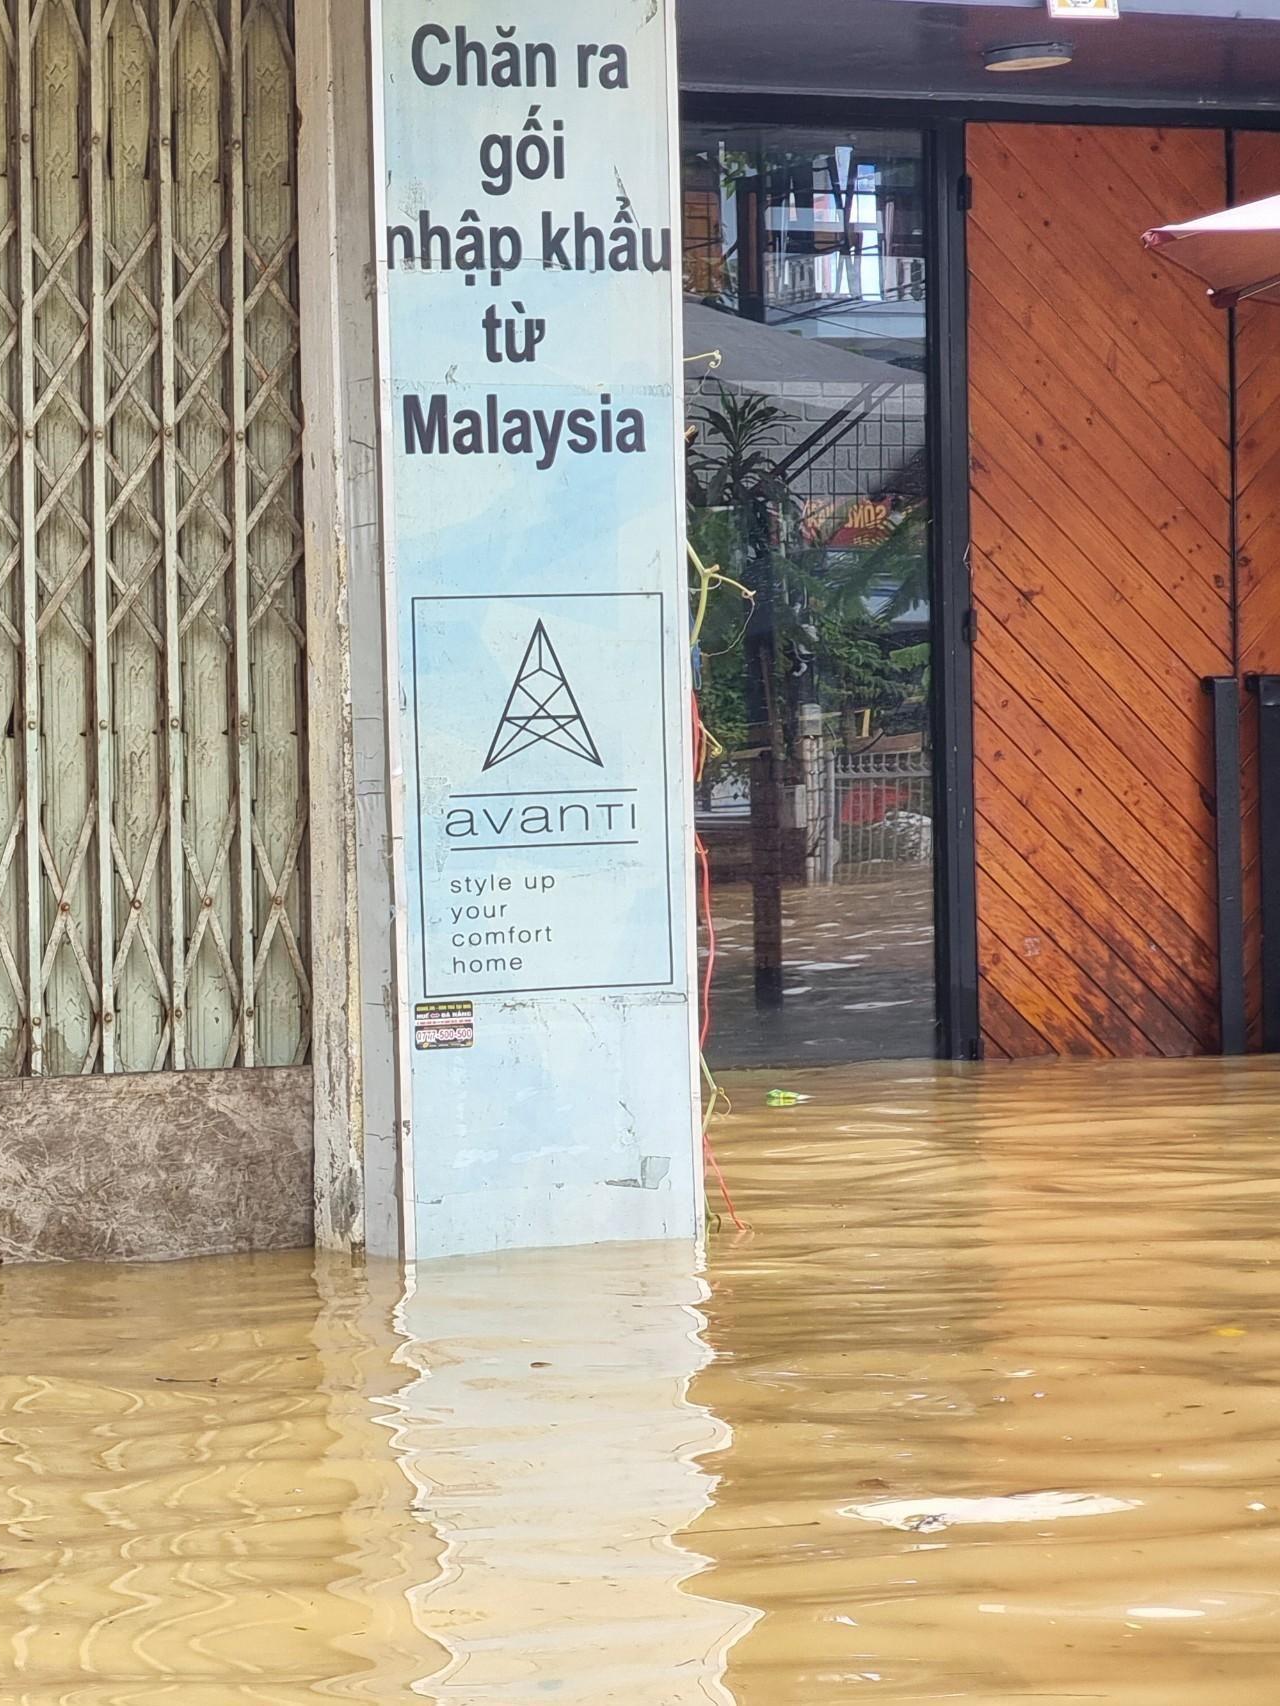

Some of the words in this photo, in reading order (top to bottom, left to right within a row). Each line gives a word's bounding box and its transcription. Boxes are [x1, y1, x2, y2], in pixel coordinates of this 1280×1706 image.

[411, 23, 557, 88] Chăn
[577, 41, 629, 90] ra
[480, 104, 566, 196] gối
[387, 209, 522, 287] nhập
[541, 196, 672, 272] khẩu
[482, 300, 546, 363] từ
[403, 393, 646, 471] Malaysia
[450, 874, 512, 896] style
[524, 874, 556, 893] up
[450, 904, 508, 925] your
[452, 926, 552, 947] comfort
[453, 956, 523, 974] home
